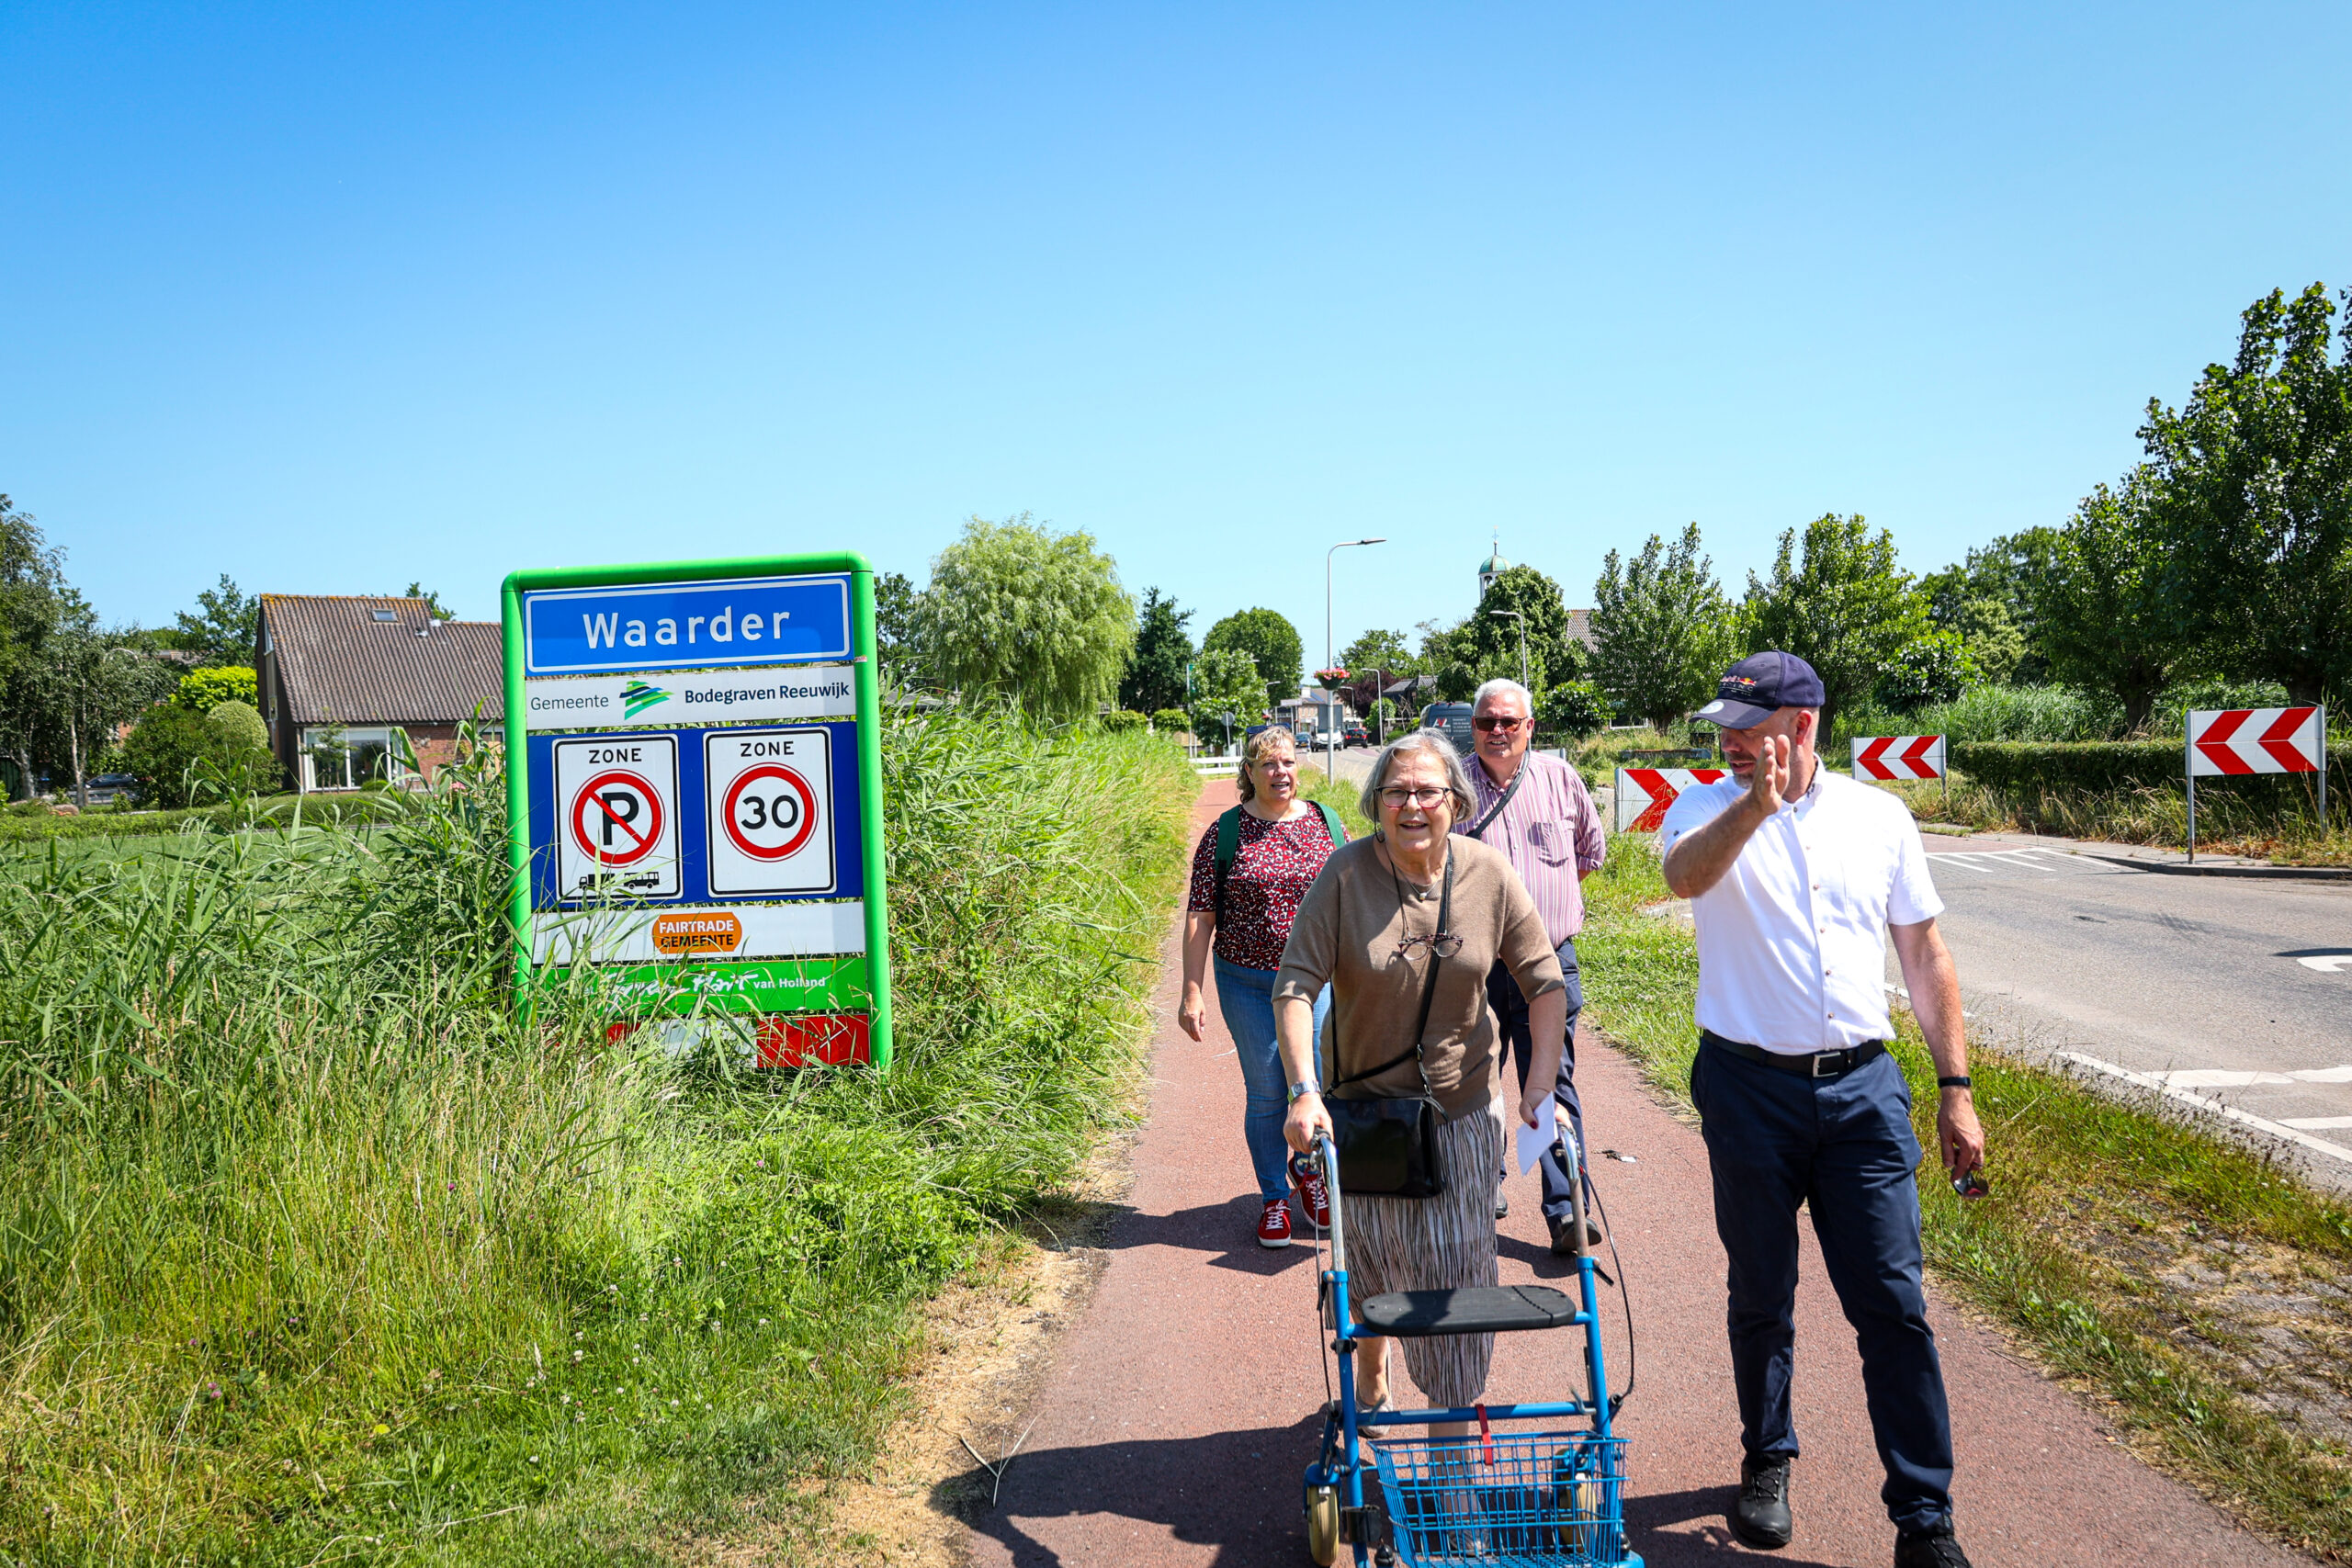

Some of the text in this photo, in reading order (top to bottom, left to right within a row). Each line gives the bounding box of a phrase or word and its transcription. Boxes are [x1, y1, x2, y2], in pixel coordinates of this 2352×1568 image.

[582, 605, 790, 649] Waarder
[530, 682, 850, 710] Gemeente Bodegraven Reeuwijk
[588, 748, 642, 764] ZONE
[740, 740, 795, 757] ZONE
[602, 792, 639, 846] P
[741, 795, 798, 829] 30
[659, 919, 734, 933] FAIRTRADE
[661, 934, 734, 948] GEMEENTE
[753, 980, 775, 989] van
[779, 976, 826, 988] Holland
